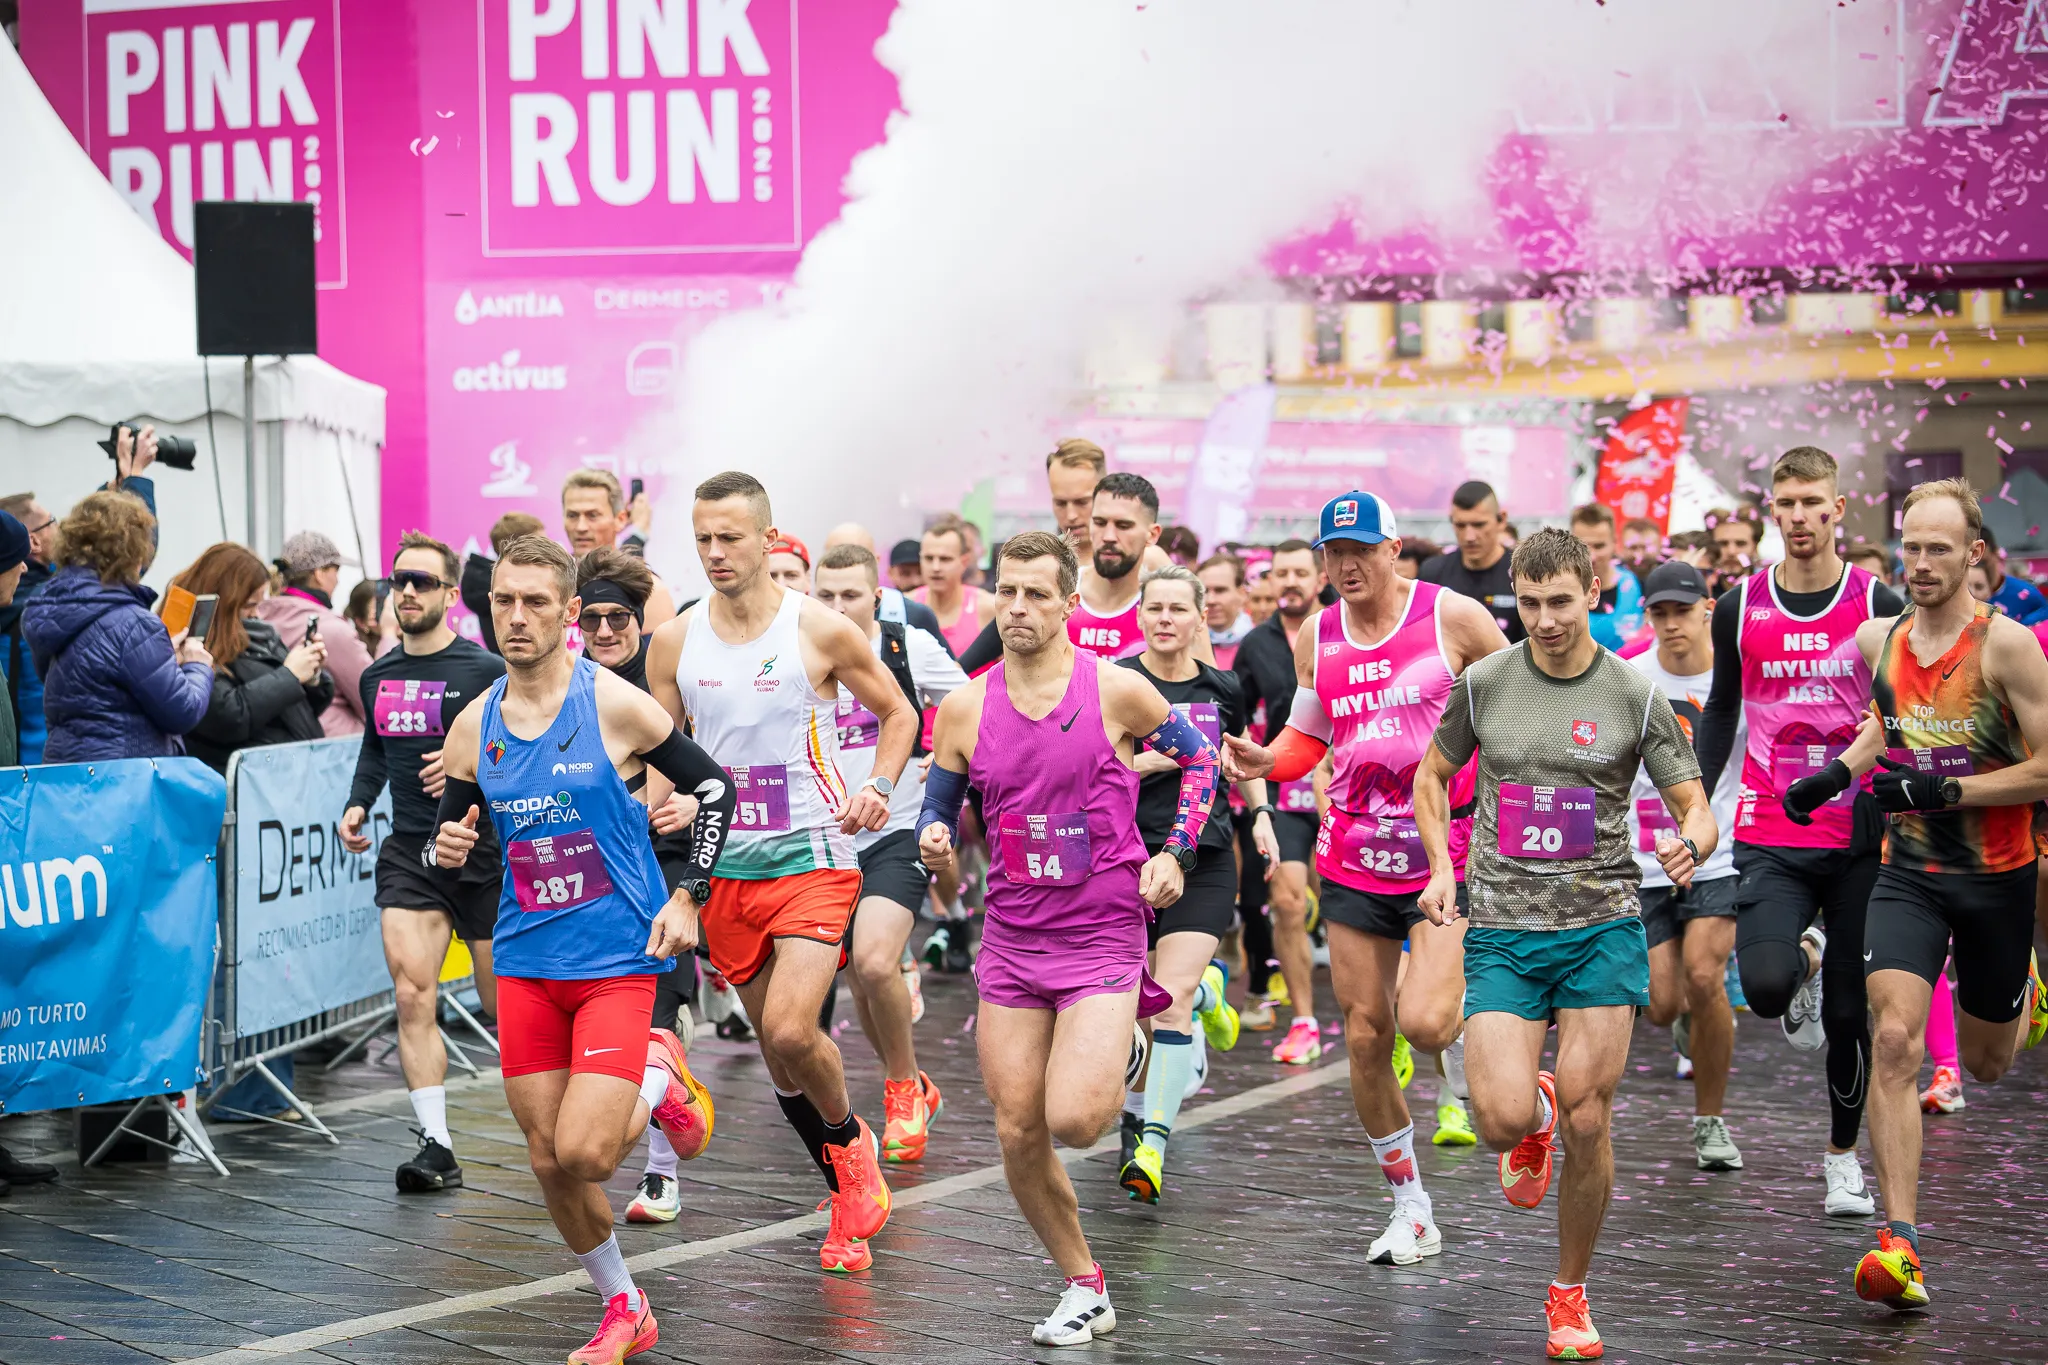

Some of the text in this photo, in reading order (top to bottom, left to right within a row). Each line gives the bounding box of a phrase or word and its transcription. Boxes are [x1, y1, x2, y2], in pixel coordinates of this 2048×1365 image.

[508, 0, 771, 81] PINK
[106, 17, 319, 136] PINK
[510, 88, 741, 207] RUN
[751, 87, 773, 203] 2025
[453, 359, 568, 392] activus
[1079, 627, 1122, 648] NES
[1783, 632, 1830, 651] NES
[1348, 659, 1392, 685] NES
[1762, 659, 1854, 679] MYLIME
[698, 679, 723, 689] Nerijus
[1331, 685, 1420, 719] MYLIME
[1787, 685, 1835, 704] JAS!
[1912, 704, 1935, 717] TOP
[387, 711, 427, 733] 233
[1356, 716, 1403, 743] JAS!
[1883, 716, 1976, 733] EXCHANGE
[568, 762, 594, 770] NORD
[1916, 755, 1932, 763] PINK
[1952, 757, 1967, 765] km
[735, 780, 749, 788] RUN
[491, 795, 558, 813] ŠKODA
[1534, 794, 1553, 803] PINK
[1534, 803, 1550, 812] RUN
[1562, 802, 1573, 810] 10
[1575, 802, 1591, 810] km
[1029, 823, 1046, 831] PINK
[1031, 831, 1046, 839] RUN
[1055, 827, 1084, 836] 10 km
[698, 811, 723, 868] NORD
[1522, 826, 1563, 852] 20
[535, 845, 554, 855] PINK
[562, 843, 593, 856] 10 km
[538, 855, 555, 864] RUN
[1026, 853, 1063, 880] 54
[1359, 847, 1409, 874] 323
[533, 872, 584, 904] 287
[27, 1002, 87, 1025] TURTO
